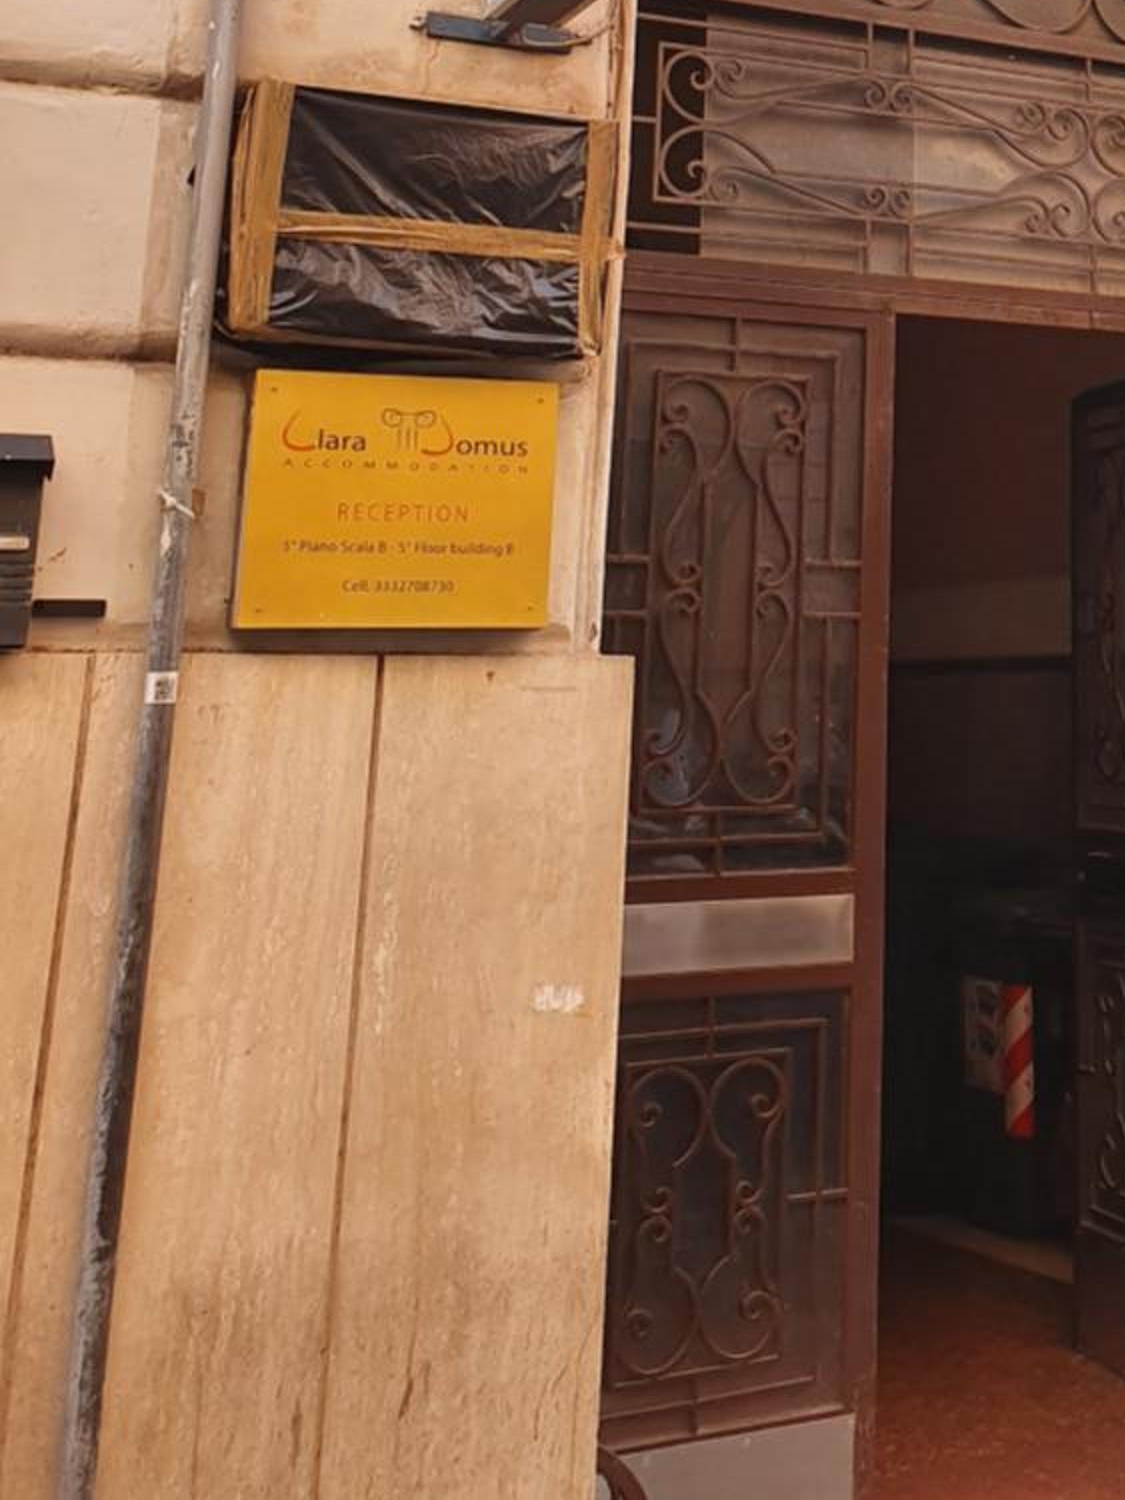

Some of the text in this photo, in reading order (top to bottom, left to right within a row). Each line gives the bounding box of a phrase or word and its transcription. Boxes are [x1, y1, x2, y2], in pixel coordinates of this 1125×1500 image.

[281, 409, 528, 457] Clara Domus
[283, 457, 528, 474] ACCOMMODATION
[337, 502, 469, 523] RECEPTION
[300, 540, 337, 553] Piano
[341, 540, 376, 553] Scala
[415, 542, 449, 555] Floor
[450, 542, 502, 557] building
